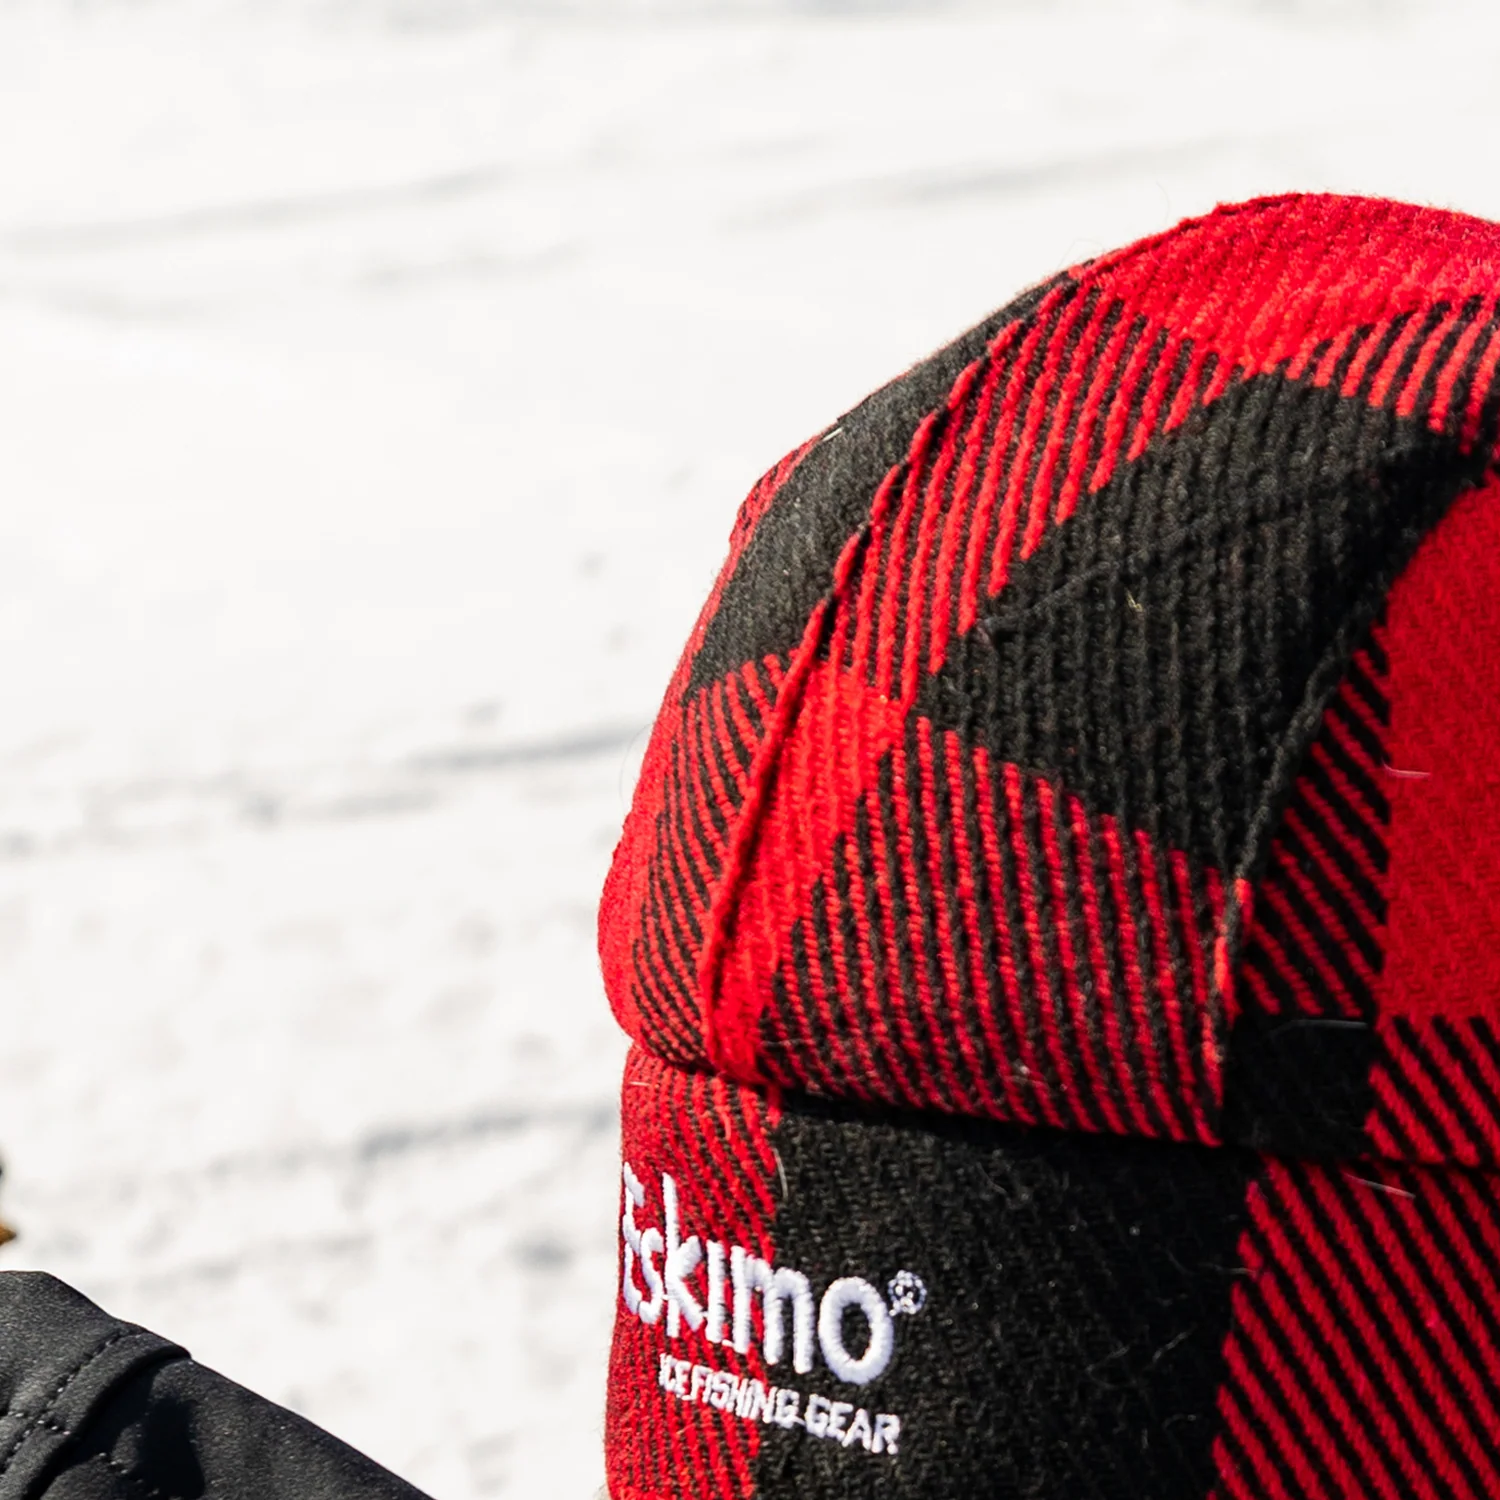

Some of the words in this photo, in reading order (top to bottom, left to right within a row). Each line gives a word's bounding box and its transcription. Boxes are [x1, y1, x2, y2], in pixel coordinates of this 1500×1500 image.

[659, 1353, 693, 1399] ICE
[689, 1364, 800, 1429] FISHING
[804, 1393, 900, 1455] GEAR
